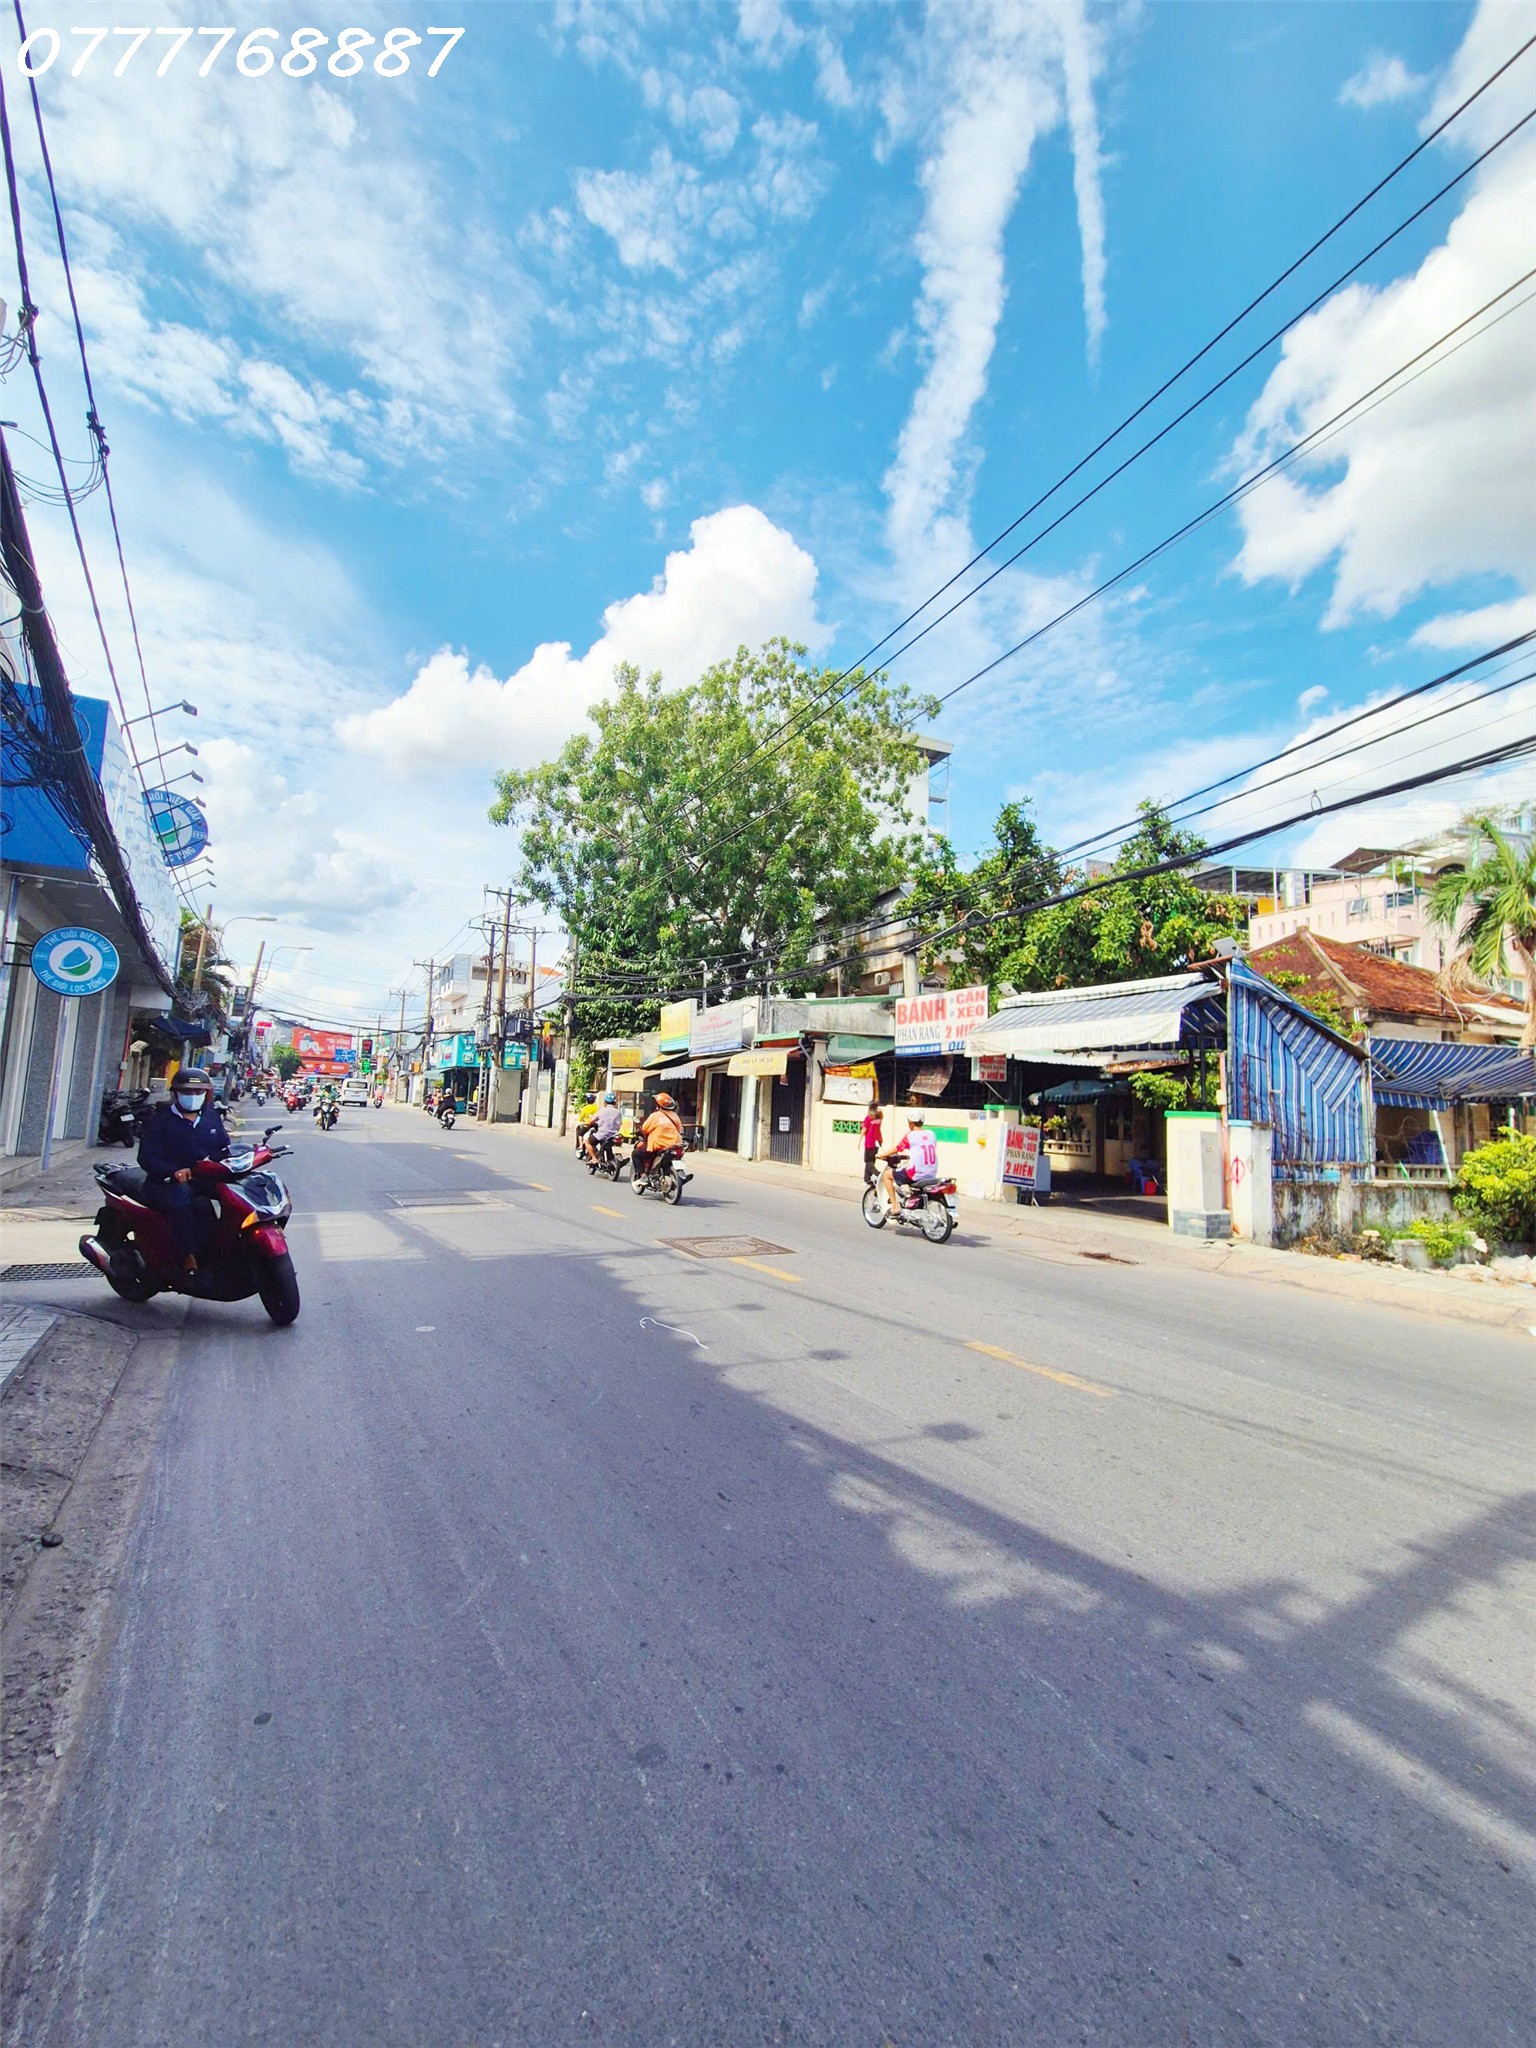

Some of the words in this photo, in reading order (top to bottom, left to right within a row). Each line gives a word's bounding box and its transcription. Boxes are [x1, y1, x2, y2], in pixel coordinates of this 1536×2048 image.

[896, 997, 946, 1025] BÁNH
[897, 1026, 917, 1043] PHAN
[919, 1025, 940, 1041] RANG
[945, 1025, 952, 1040] 2
[921, 1144, 936, 1166] 10
[1004, 1160, 1012, 1174] 2
